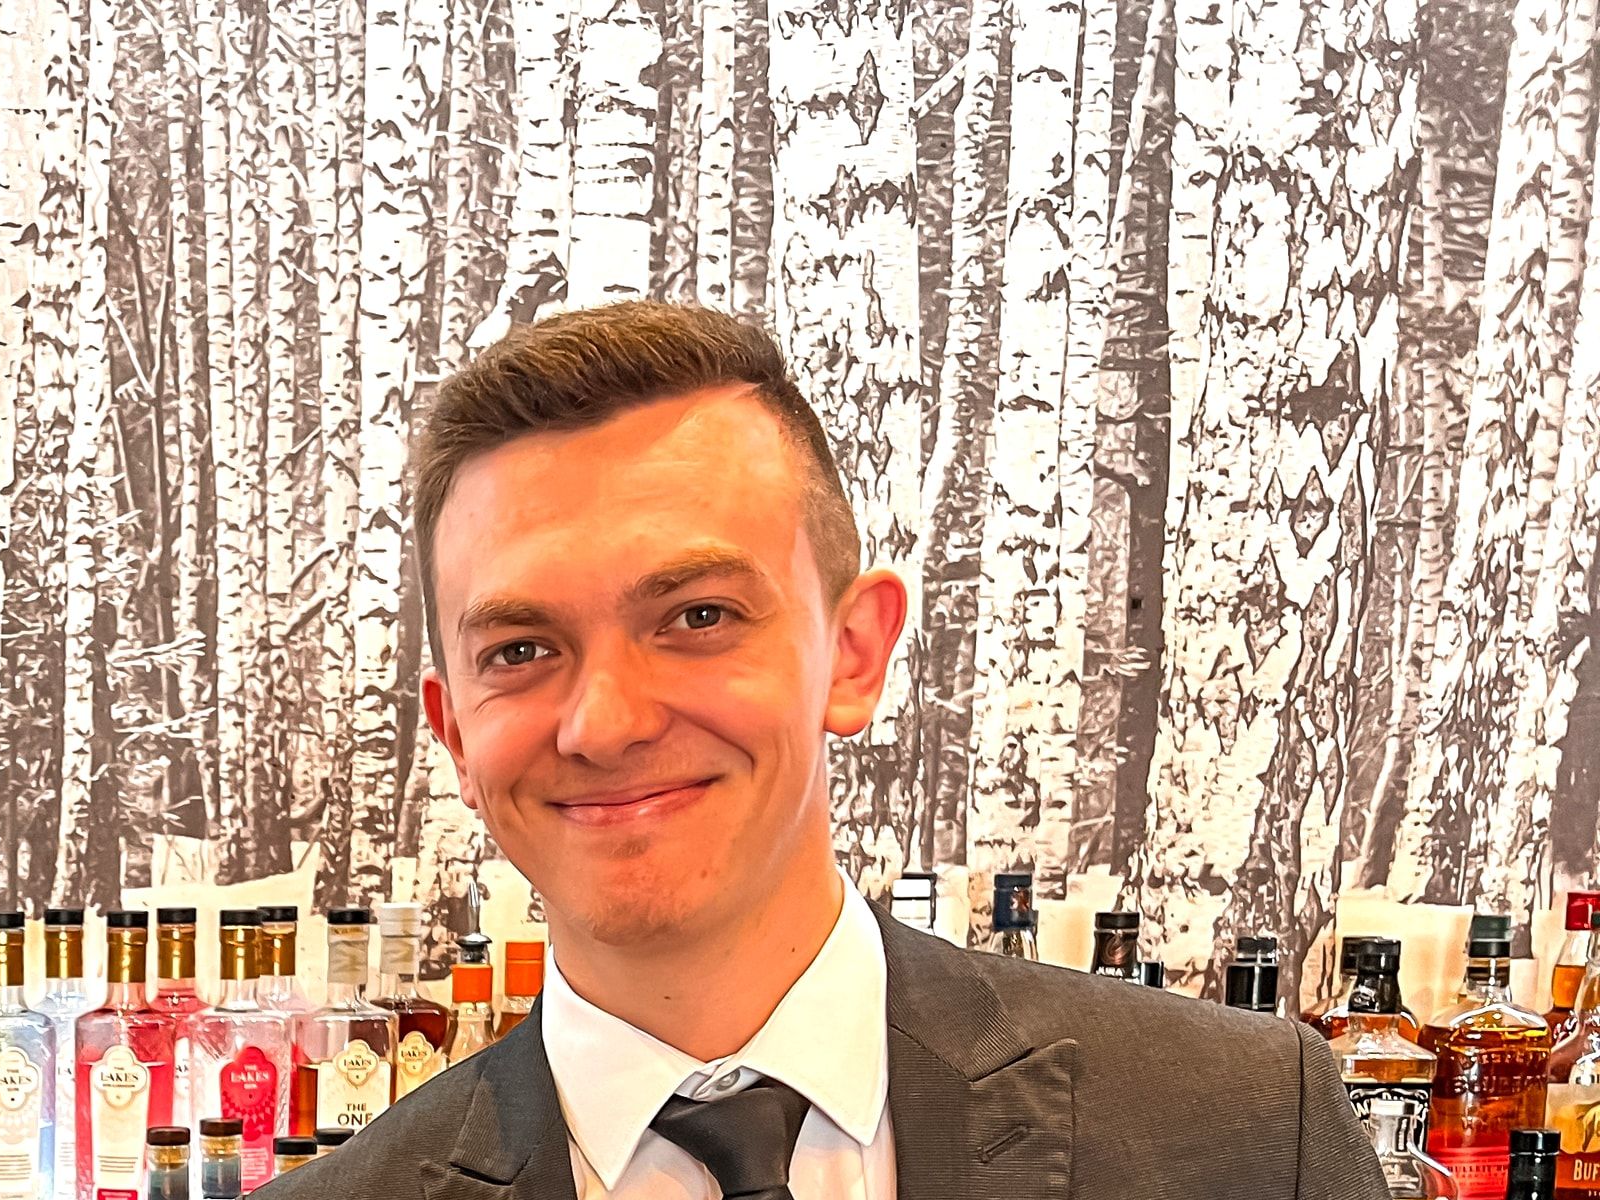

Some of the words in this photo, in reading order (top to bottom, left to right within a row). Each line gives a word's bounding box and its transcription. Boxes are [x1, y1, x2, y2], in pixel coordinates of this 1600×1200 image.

[344, 1059, 372, 1067] LAKES
[100, 1071, 139, 1082] LAKES
[231, 1071, 269, 1083] LAKES
[346, 1103, 366, 1112] THE
[337, 1113, 373, 1126] ONE
